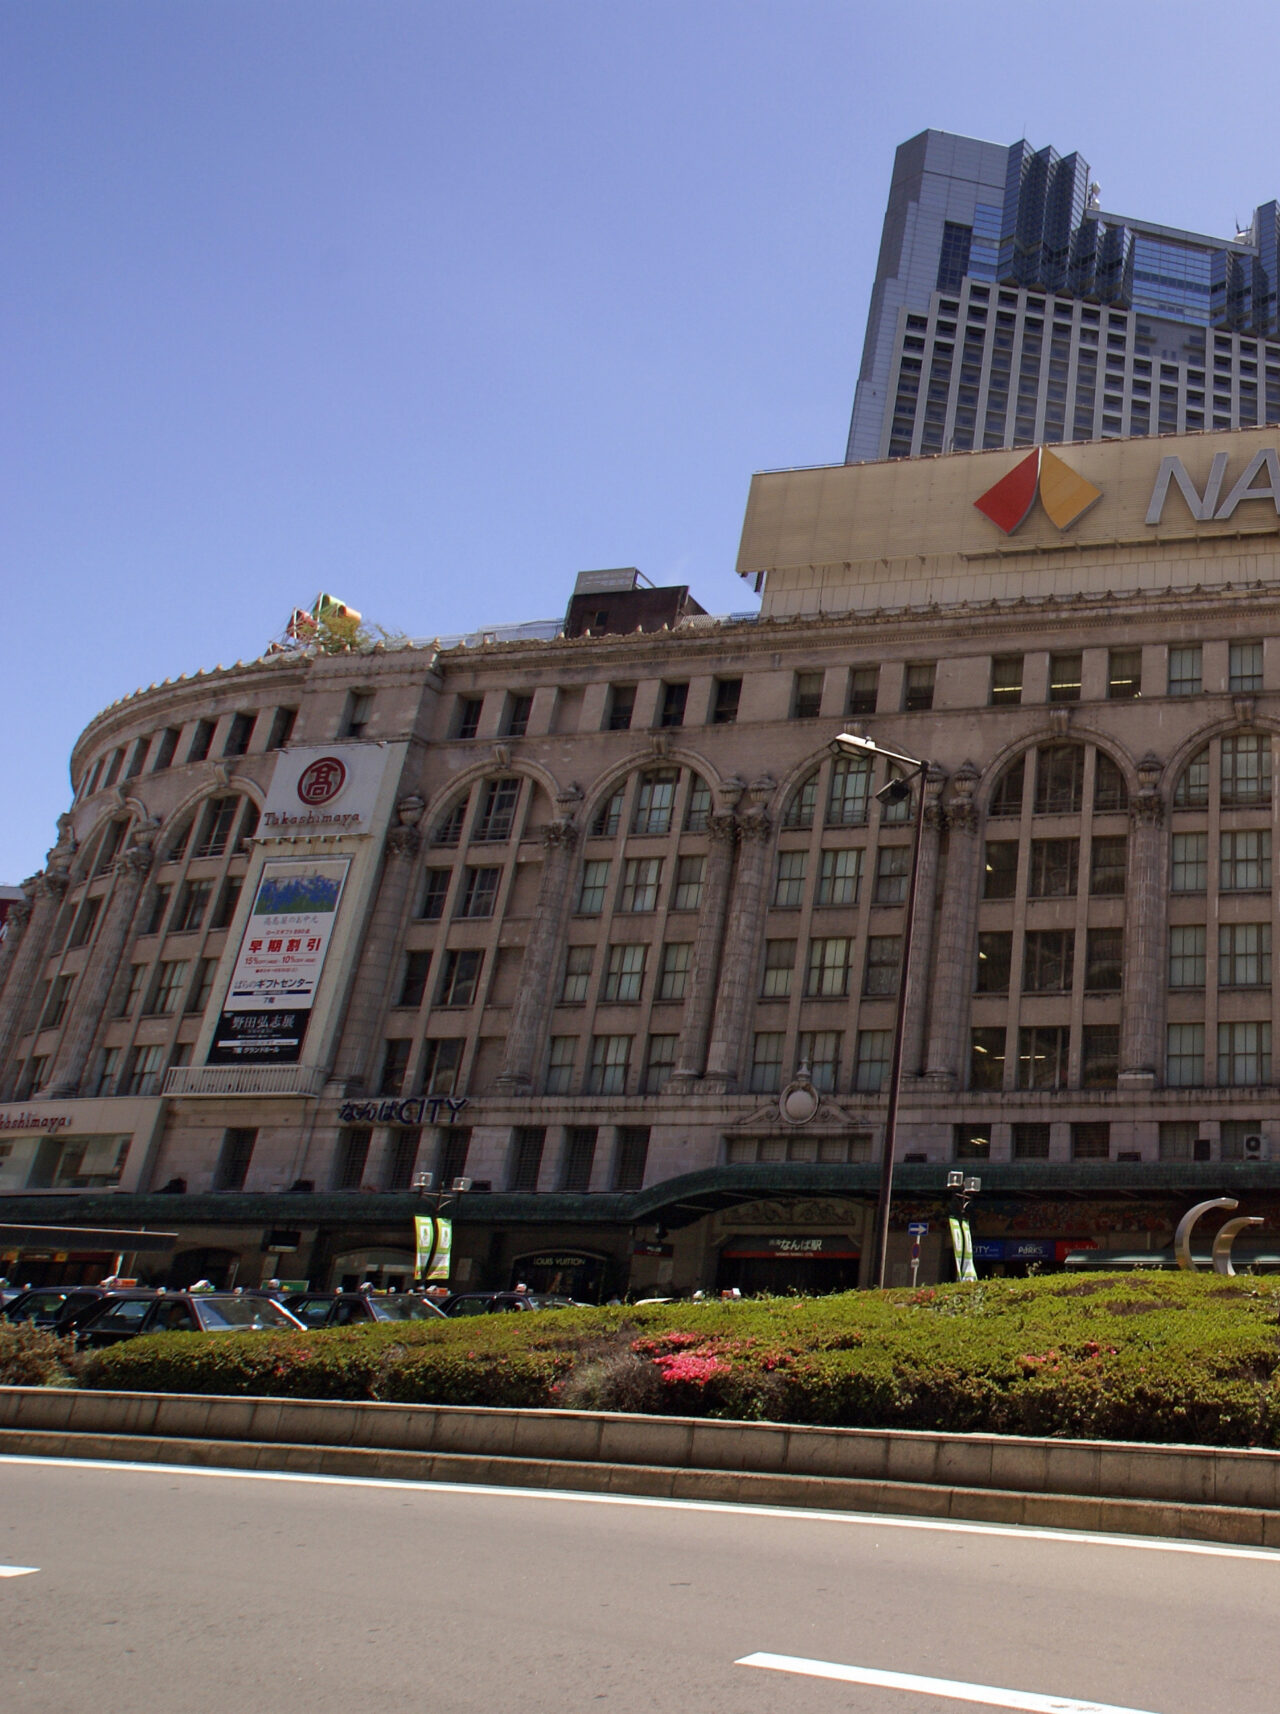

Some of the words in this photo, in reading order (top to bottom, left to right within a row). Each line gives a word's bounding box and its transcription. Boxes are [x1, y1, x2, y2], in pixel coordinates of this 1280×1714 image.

[264, 811, 361, 827] Takashimaya
[249, 937, 321, 954] 早期割引
